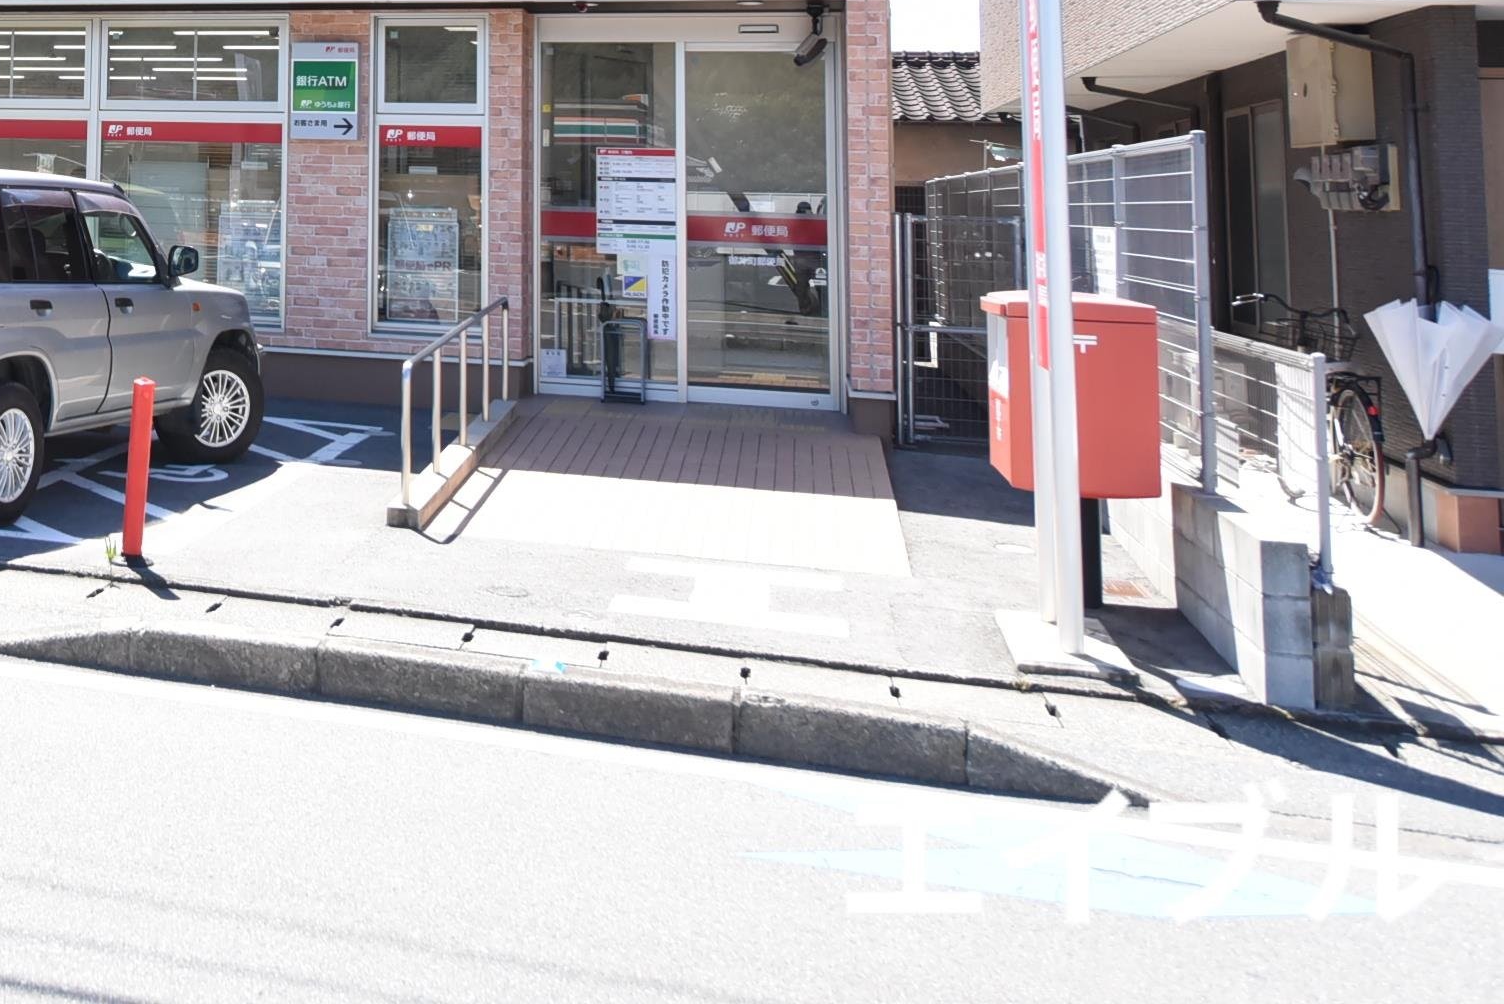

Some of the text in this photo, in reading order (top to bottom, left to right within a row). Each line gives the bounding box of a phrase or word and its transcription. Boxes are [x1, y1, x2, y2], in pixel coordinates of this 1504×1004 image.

[295, 75, 347, 87] 銀行ATM
[314, 101, 351, 109] ゆうちょ銀行
[126, 126, 152, 136] 郵便局
[407, 131, 436, 141] 郵便局
[751, 224, 789, 237] 郵便局
